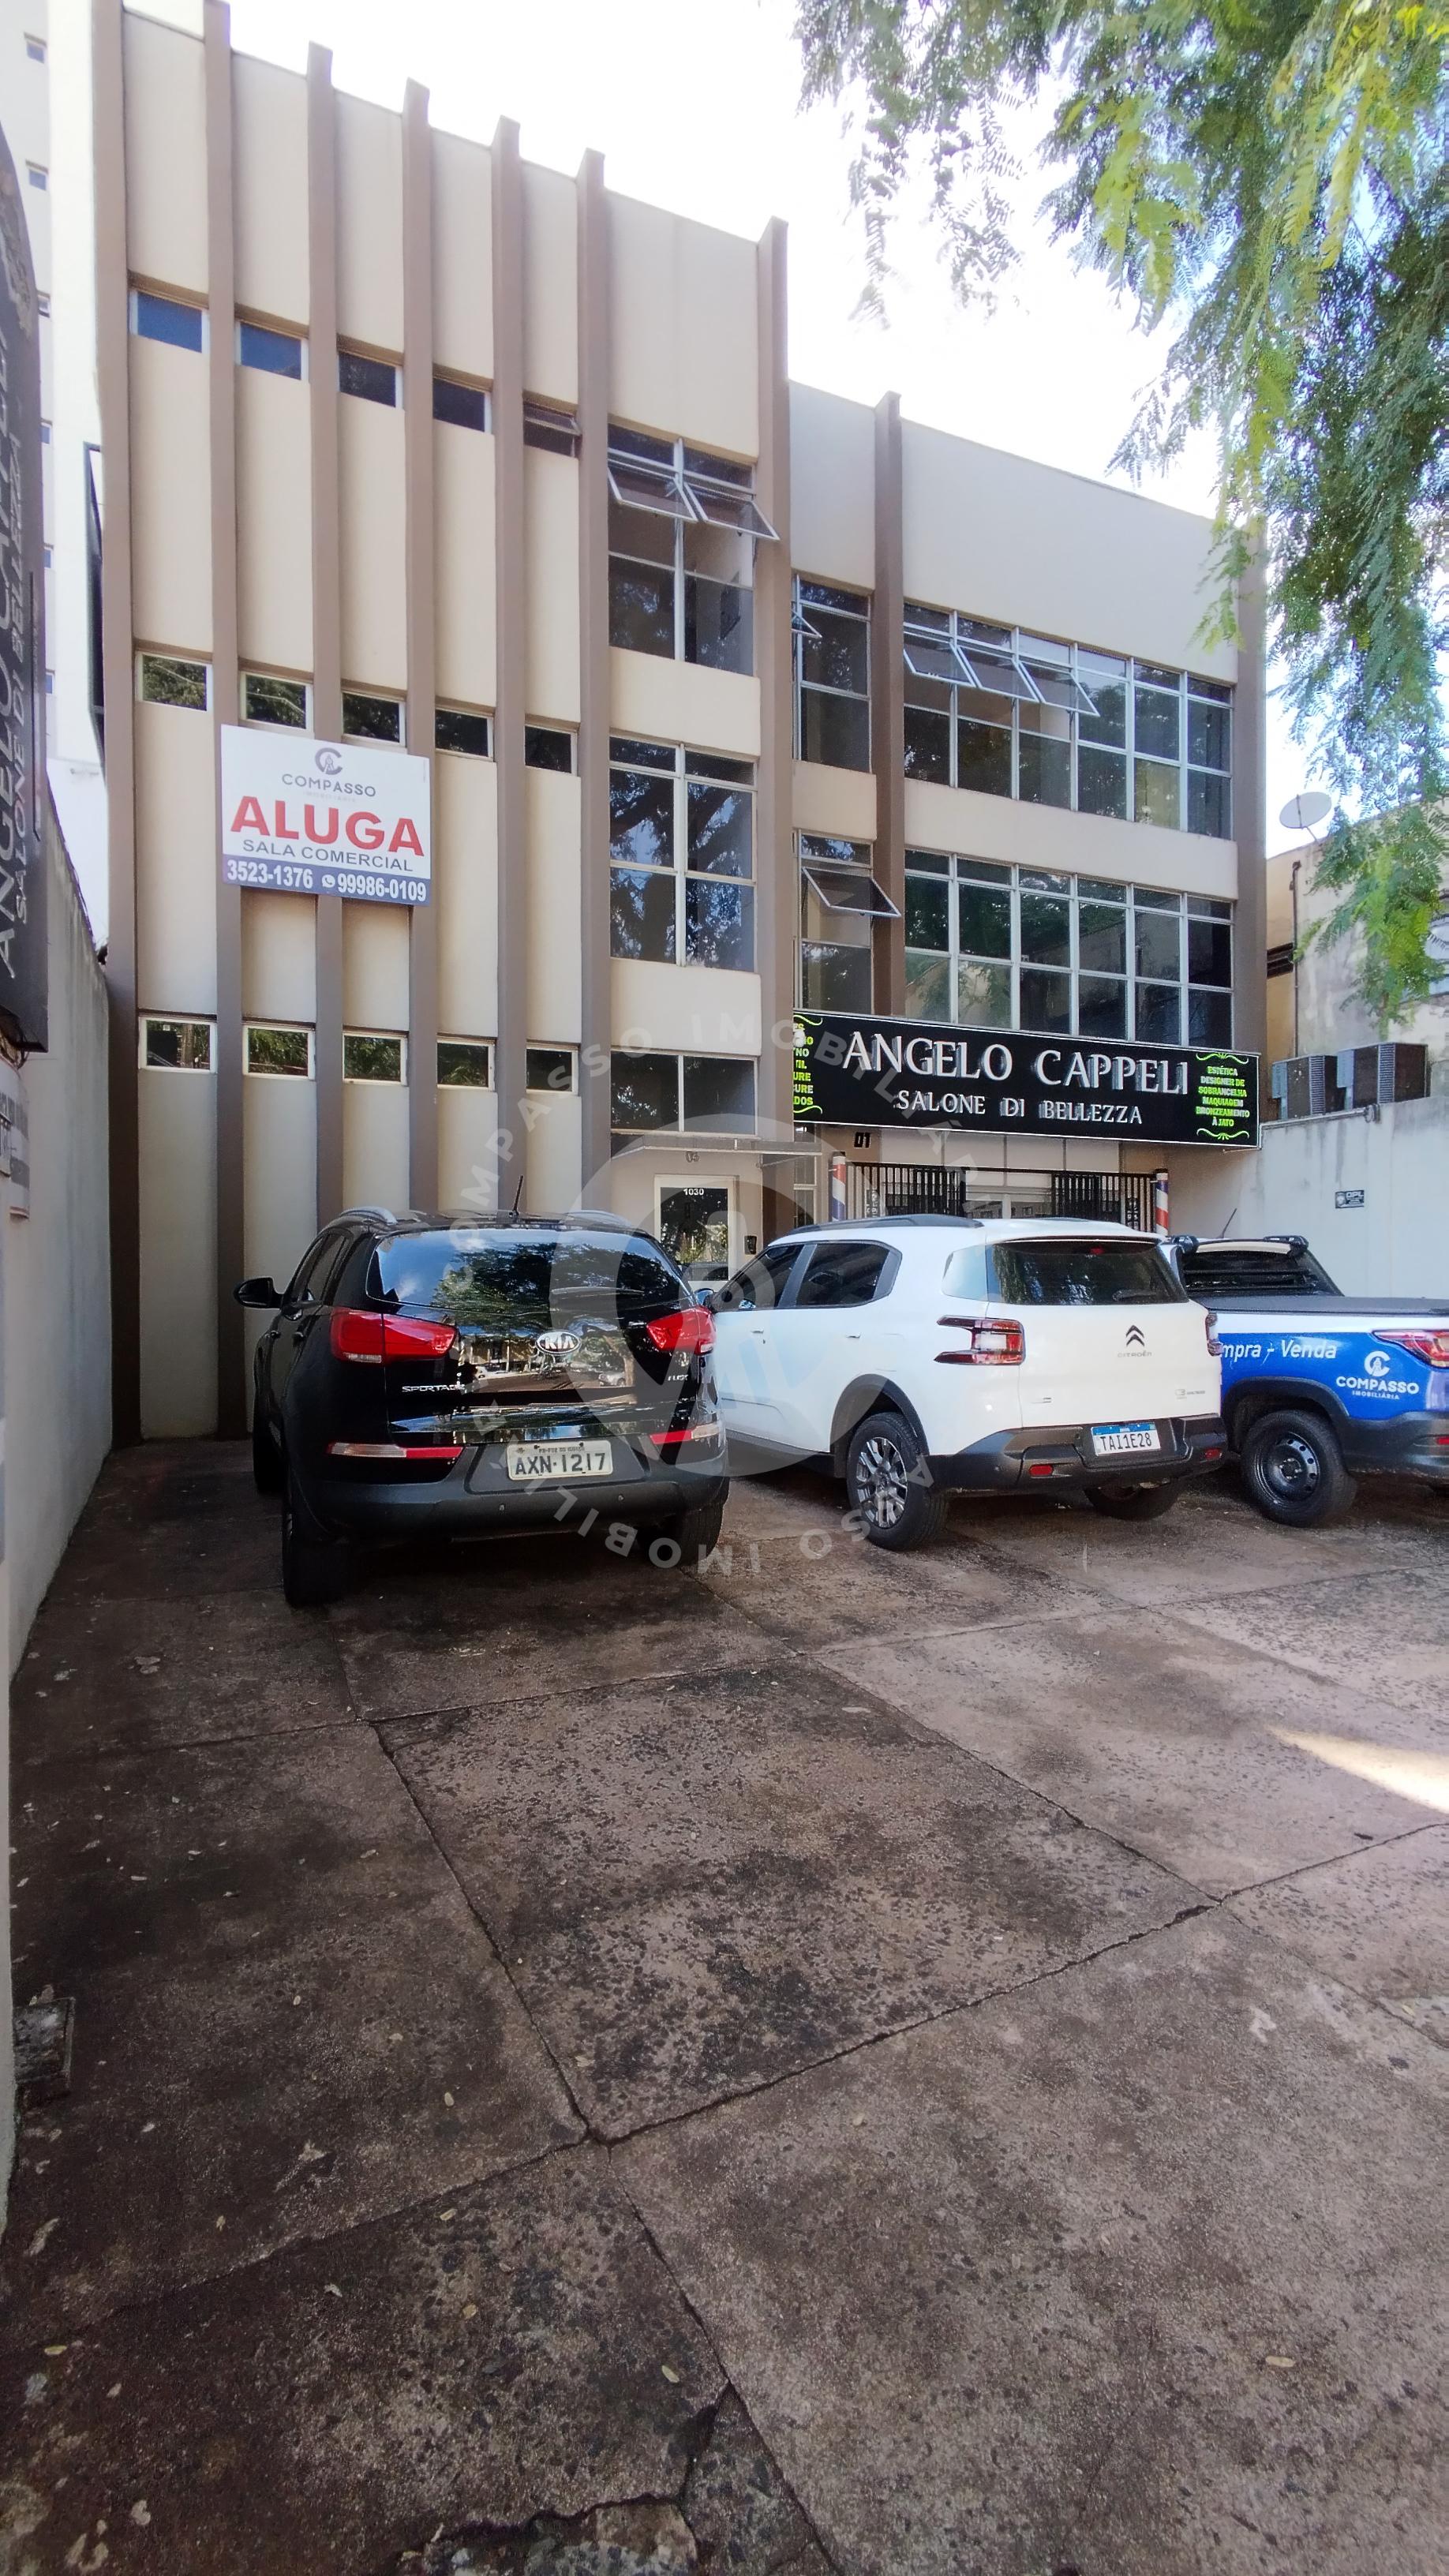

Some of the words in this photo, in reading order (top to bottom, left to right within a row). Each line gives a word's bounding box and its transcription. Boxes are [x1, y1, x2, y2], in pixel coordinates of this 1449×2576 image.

[281, 773, 376, 798] COMPASSO
[230, 796, 425, 857] ALUGA
[242, 839, 296, 858] SALA
[301, 846, 414, 872] COMERCIAL
[227, 859, 314, 889] 3523-1376
[337, 873, 427, 902] 99986-0109
[841, 1031, 1013, 1081] ANGELO
[1033, 1049, 1189, 1095] CAPPELI
[1200, 1076, 1235, 1087] DESIGNER
[1235, 1078, 1245, 1088] DE
[1198, 1086, 1247, 1098] SOBRANCELHA
[1202, 1095, 1244, 1107] MAQUIAGEM
[894, 1090, 987, 1114] SALONE
[999, 1097, 1025, 1118] DI
[1038, 1099, 1143, 1125] BELLEZZA
[1196, 1106, 1250, 1118] BRONZEAMENTO
[1219, 1118, 1234, 1127] JATO
[854, 1132, 871, 1149] 01
[545, 1335, 575, 1350] KIA
[1281, 1339, 1338, 1360] Venda
[1335, 1376, 1420, 1395] COMPASSO
[1099, 1432, 1152, 1451] TAI1E28
